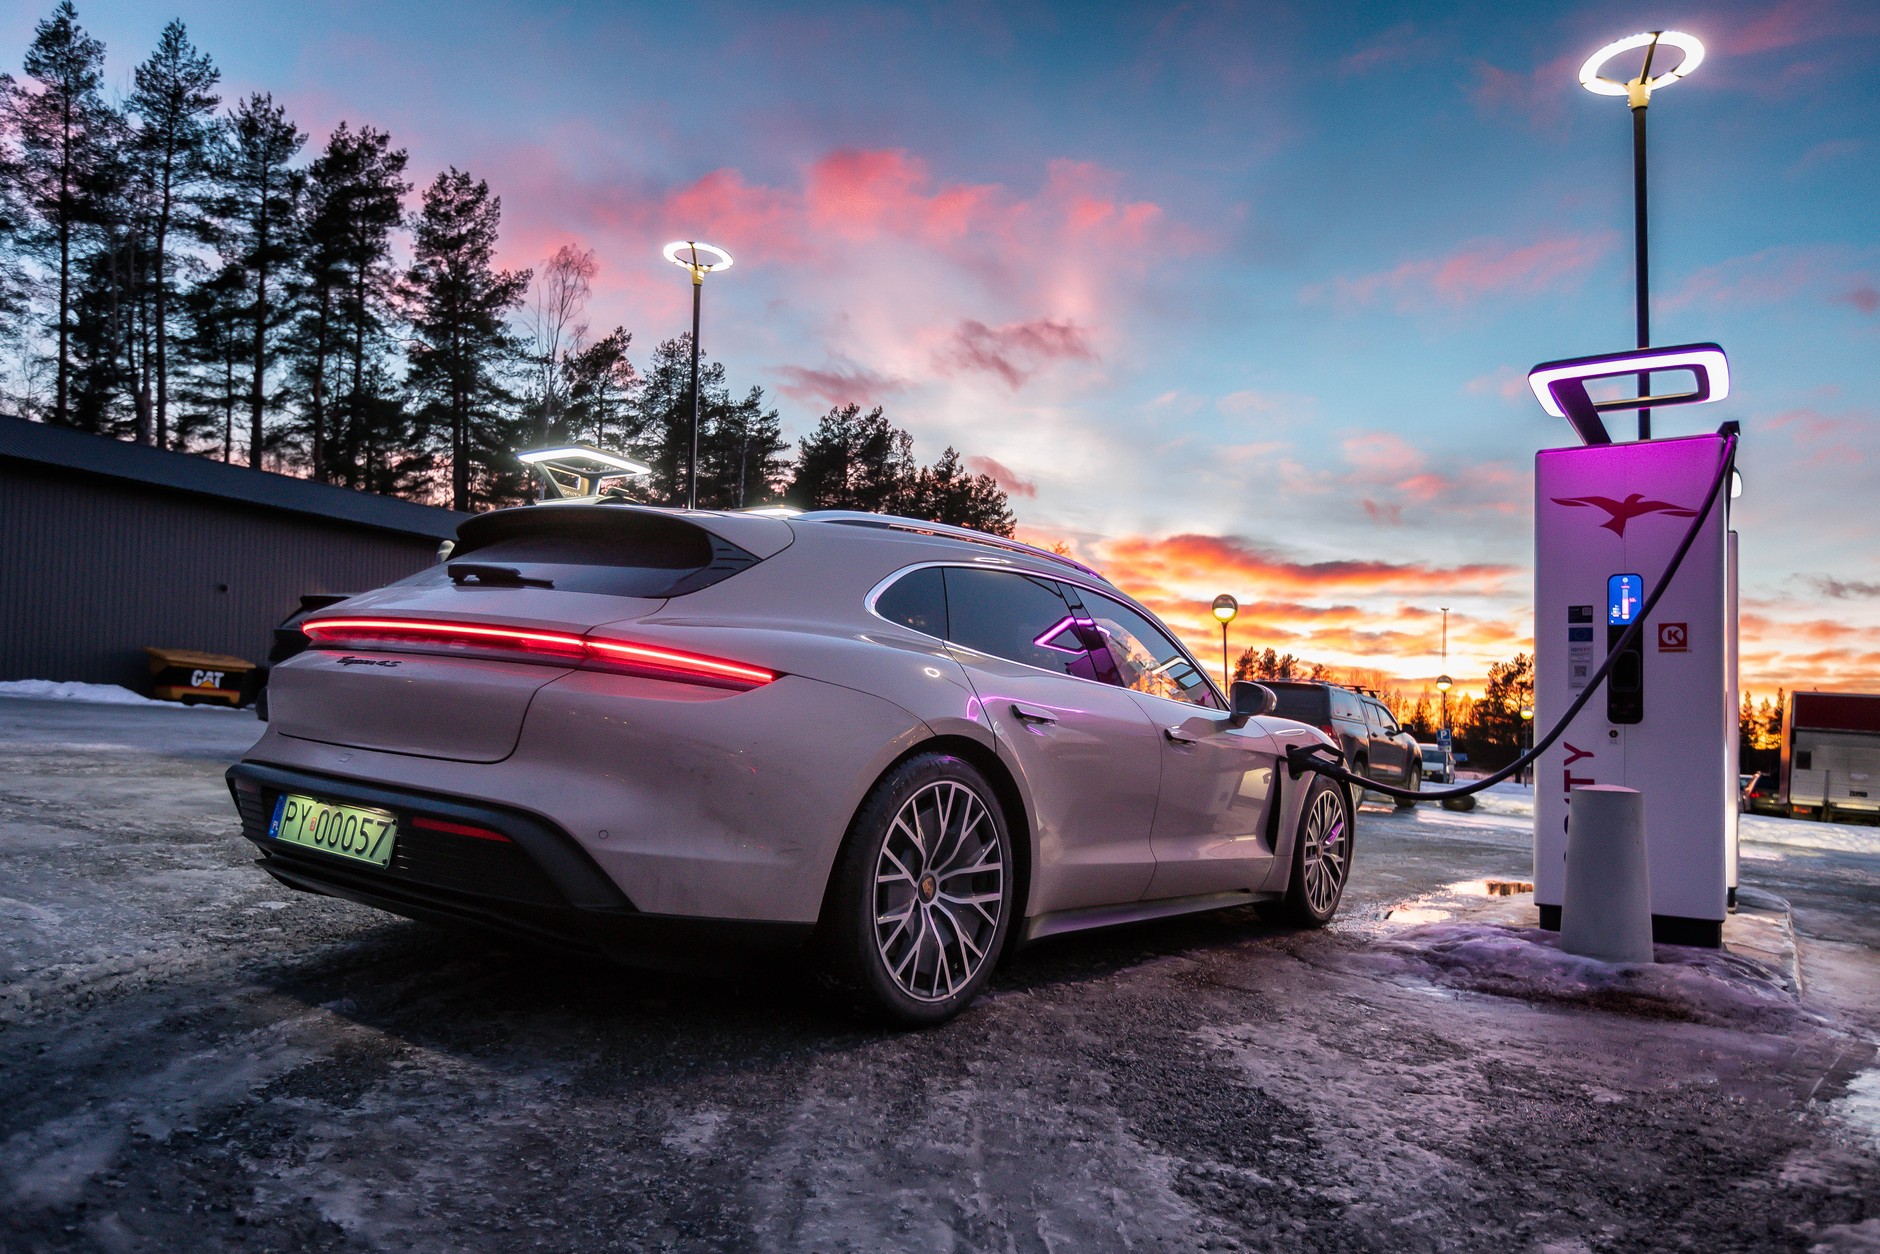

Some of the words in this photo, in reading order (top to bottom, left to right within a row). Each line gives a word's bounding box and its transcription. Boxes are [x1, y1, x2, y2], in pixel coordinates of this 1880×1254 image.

[191, 669, 225, 689] CAT
[1441, 731, 1447, 739] P
[281, 800, 313, 841] PY
[314, 808, 391, 858] 00057
